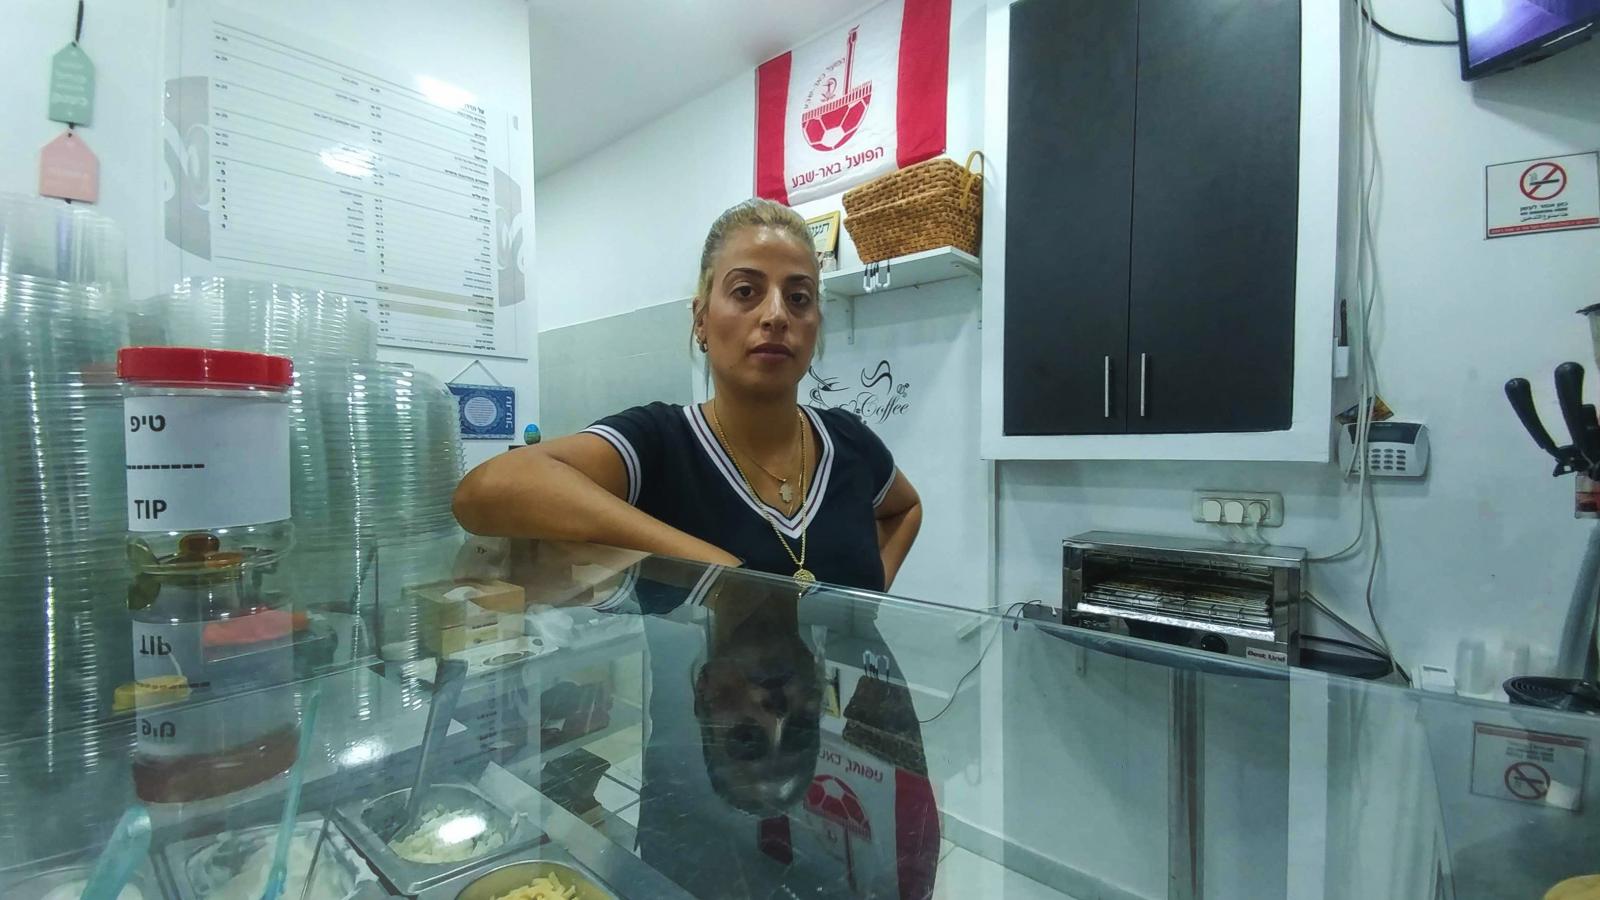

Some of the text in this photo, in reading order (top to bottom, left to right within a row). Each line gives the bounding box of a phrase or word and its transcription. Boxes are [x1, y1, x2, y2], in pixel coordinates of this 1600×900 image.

[792, 146, 884, 188] הפועל באר-שבע
[857, 392, 909, 424] Coffee
[130, 415, 166, 432] טיפ
[134, 500, 167, 519] TIP
